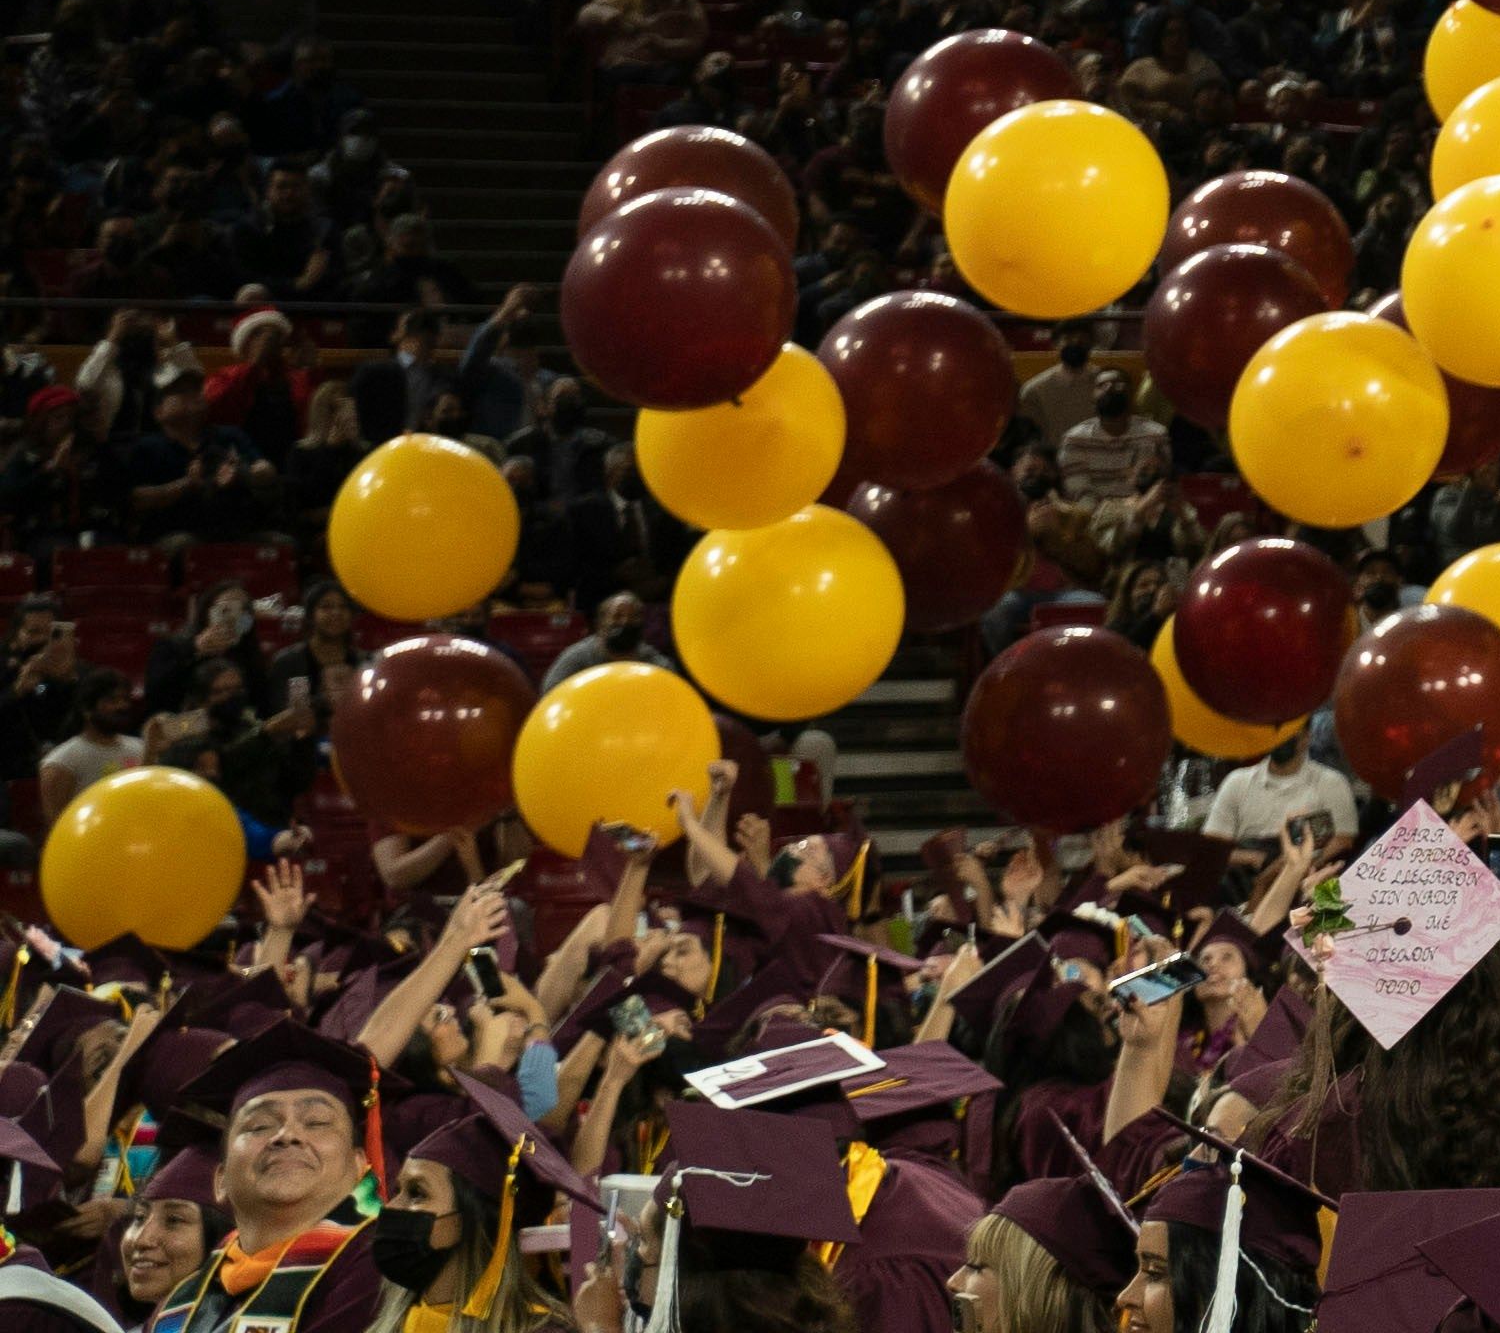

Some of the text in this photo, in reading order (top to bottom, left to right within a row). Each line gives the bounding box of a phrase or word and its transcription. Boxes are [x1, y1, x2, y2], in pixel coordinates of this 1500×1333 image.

[1393, 826, 1445, 843] PARA
[1370, 844, 1472, 866] MIS PADRES
[1355, 862, 1485, 887] QUE LLEGARON
[1368, 890, 1460, 906] SIN NADA
[1425, 915, 1451, 931] ME
[1375, 977, 1421, 995] TODO
